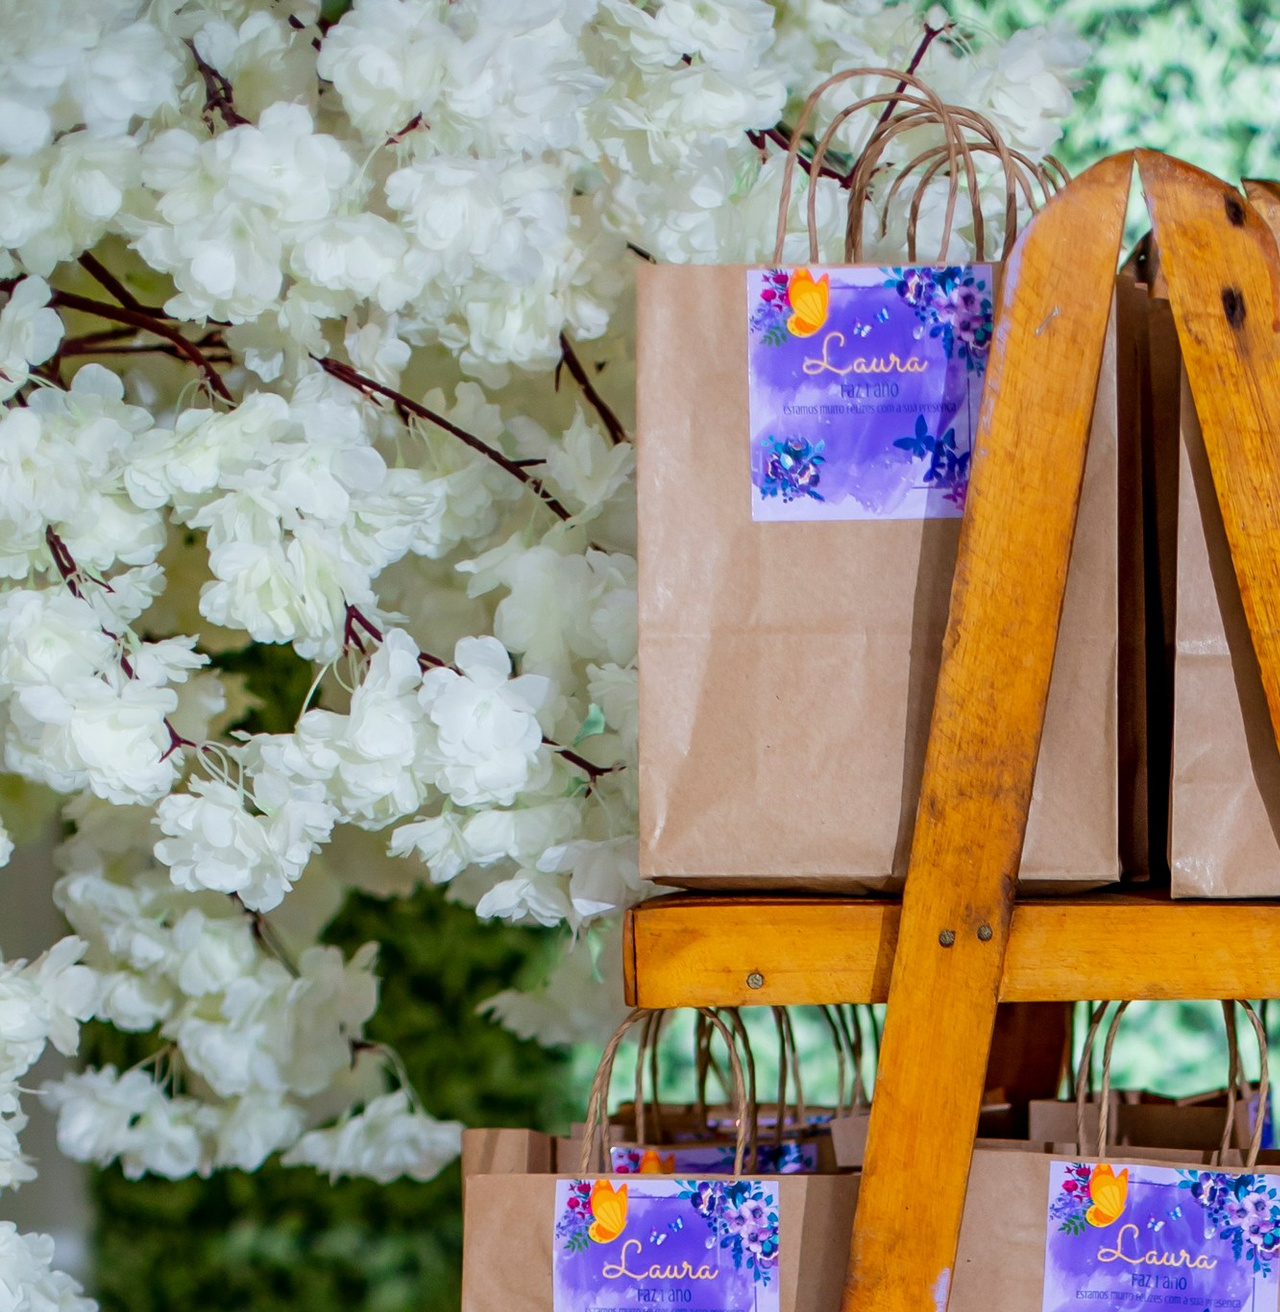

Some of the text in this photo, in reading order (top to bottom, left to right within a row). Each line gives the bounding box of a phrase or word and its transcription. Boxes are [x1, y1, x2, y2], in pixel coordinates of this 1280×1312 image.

[802, 331, 928, 376] Laura
[873, 381, 900, 399] ano
[1097, 1223, 1218, 1271] Laura
[602, 1238, 719, 1280] Laura
[1131, 1273, 1151, 1289] Faz
[1162, 1275, 1188, 1291] ano
[637, 1288, 657, 1303] Faz
[667, 1288, 692, 1303] ano
[1075, 1290, 1109, 1300] Estamos
[1189, 1296, 1204, 1307] sua
